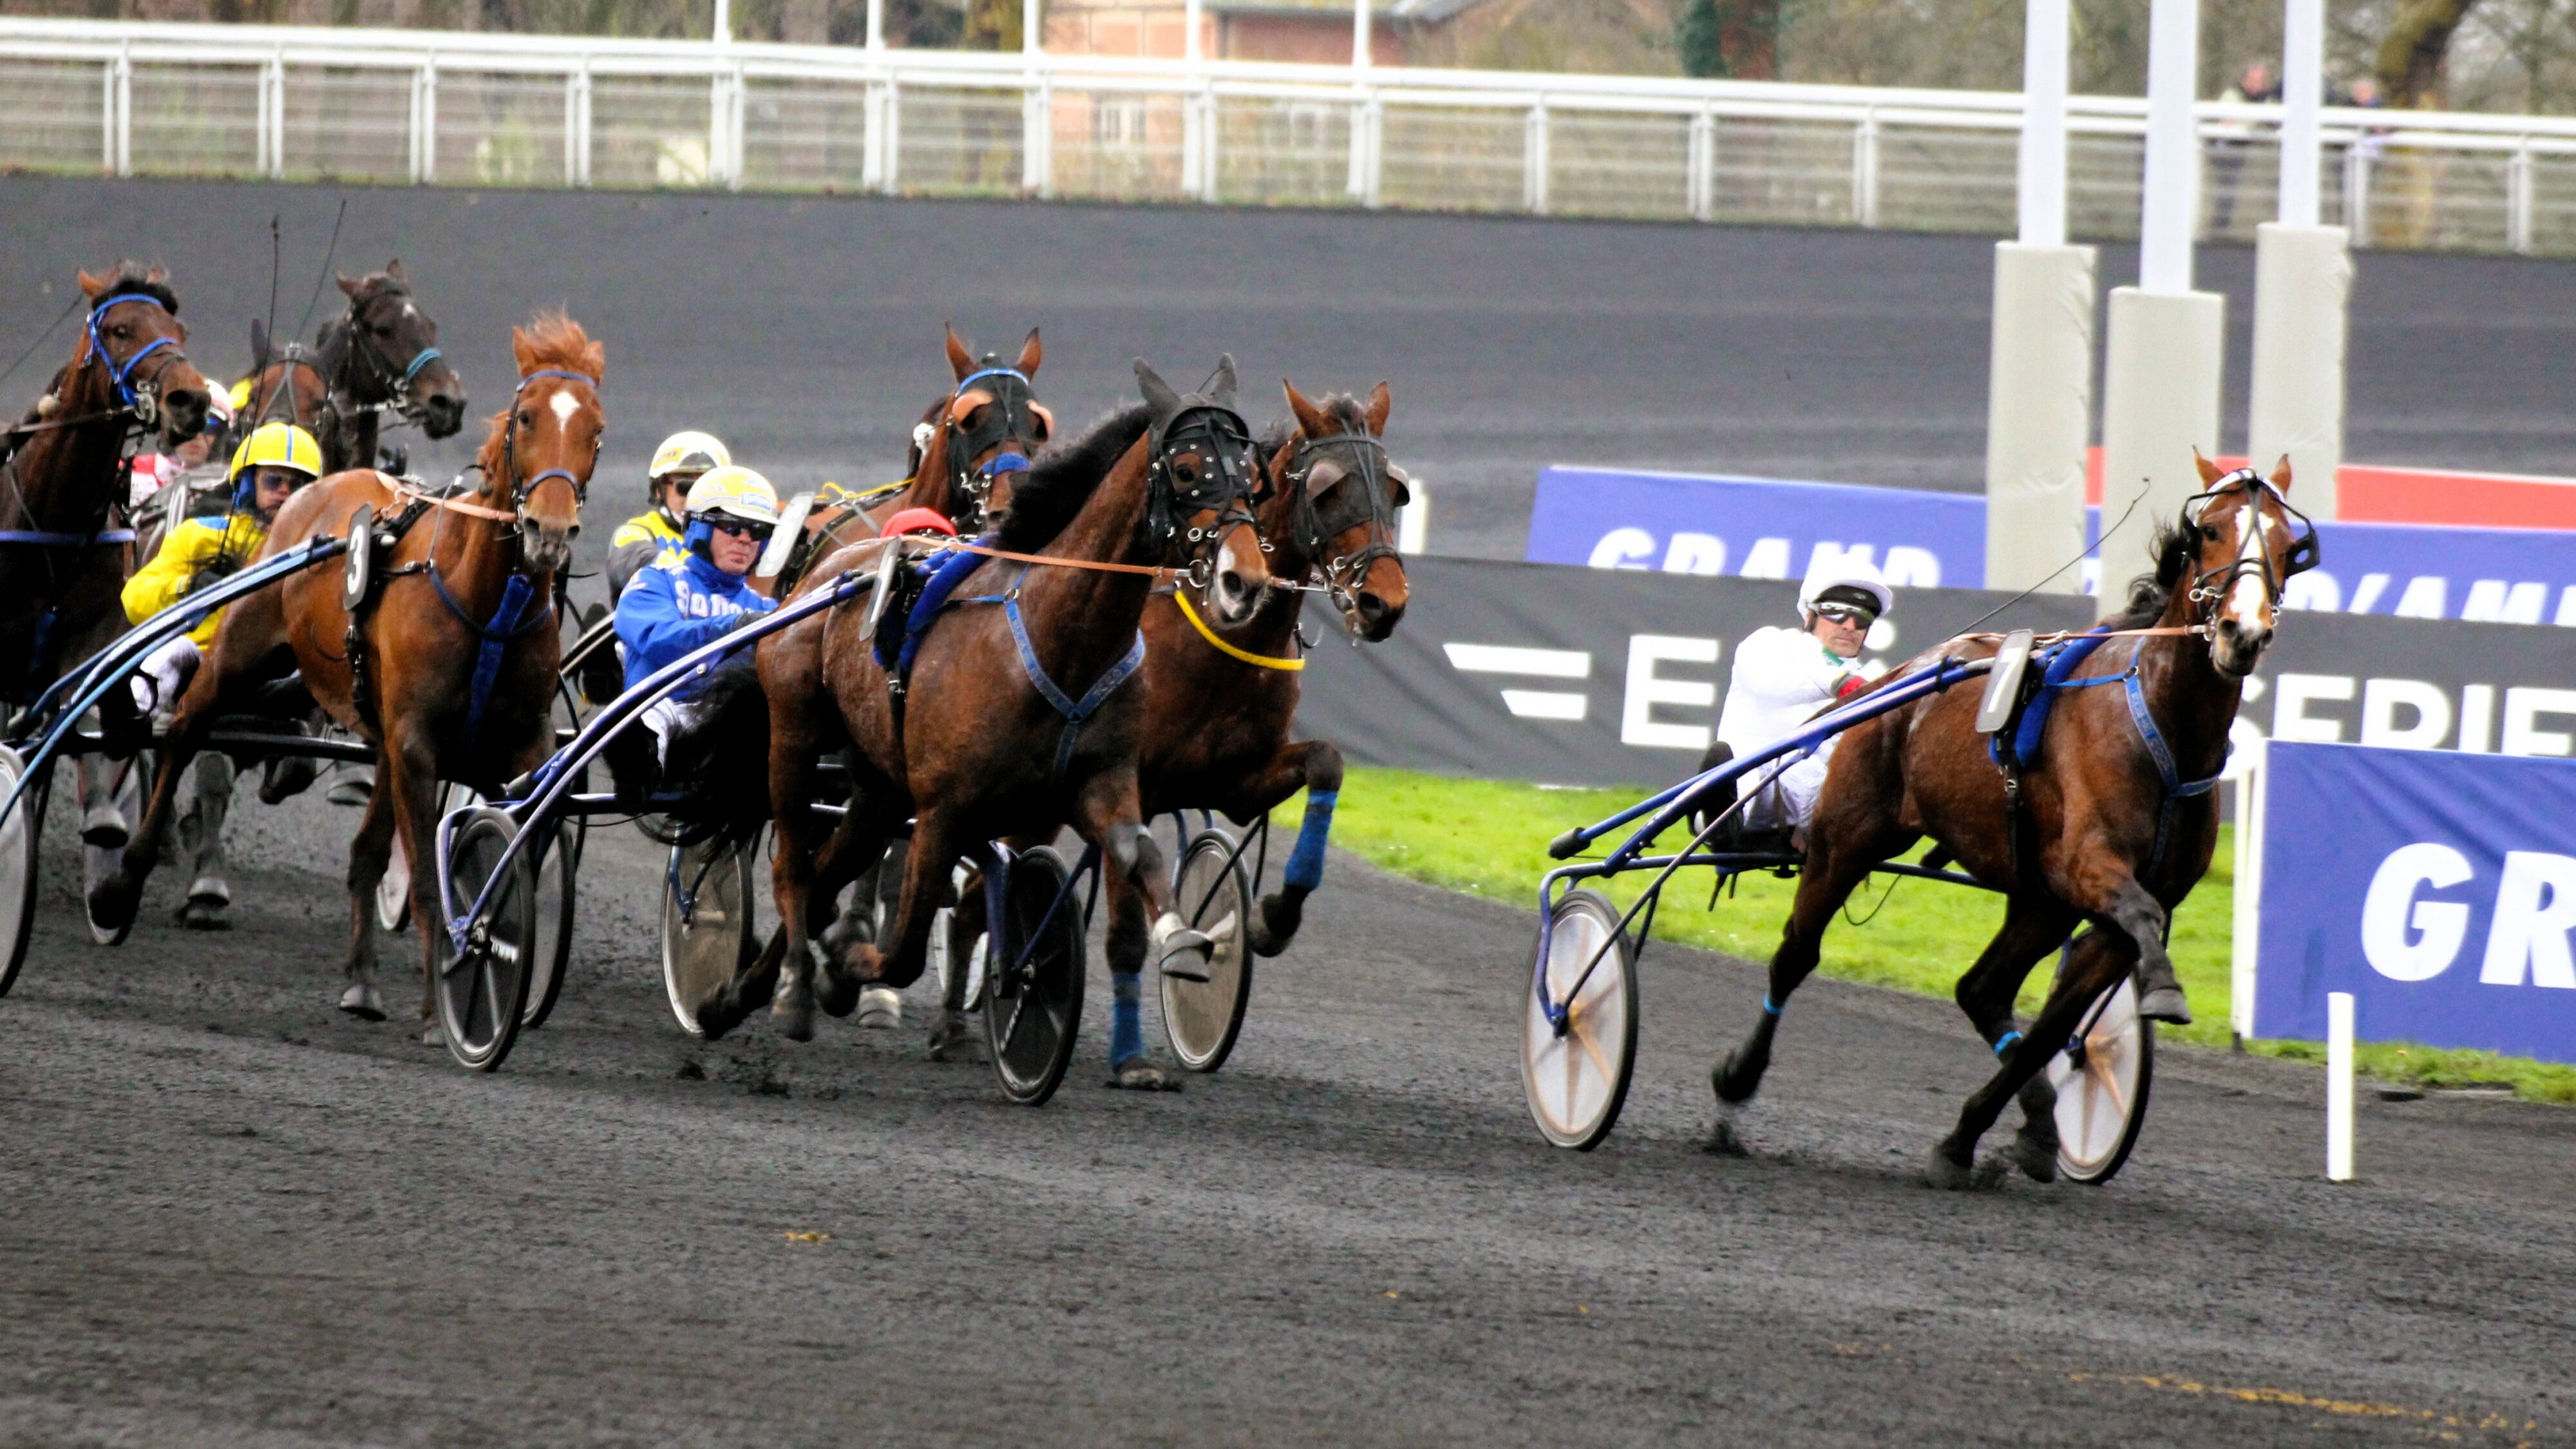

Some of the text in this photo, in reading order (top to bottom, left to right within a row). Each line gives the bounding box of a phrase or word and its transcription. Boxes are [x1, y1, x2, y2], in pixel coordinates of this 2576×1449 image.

[347, 525, 364, 595] 3
[870, 556, 895, 623] 1
[1987, 647, 2023, 713] 7
[2361, 842, 2576, 989] GR
